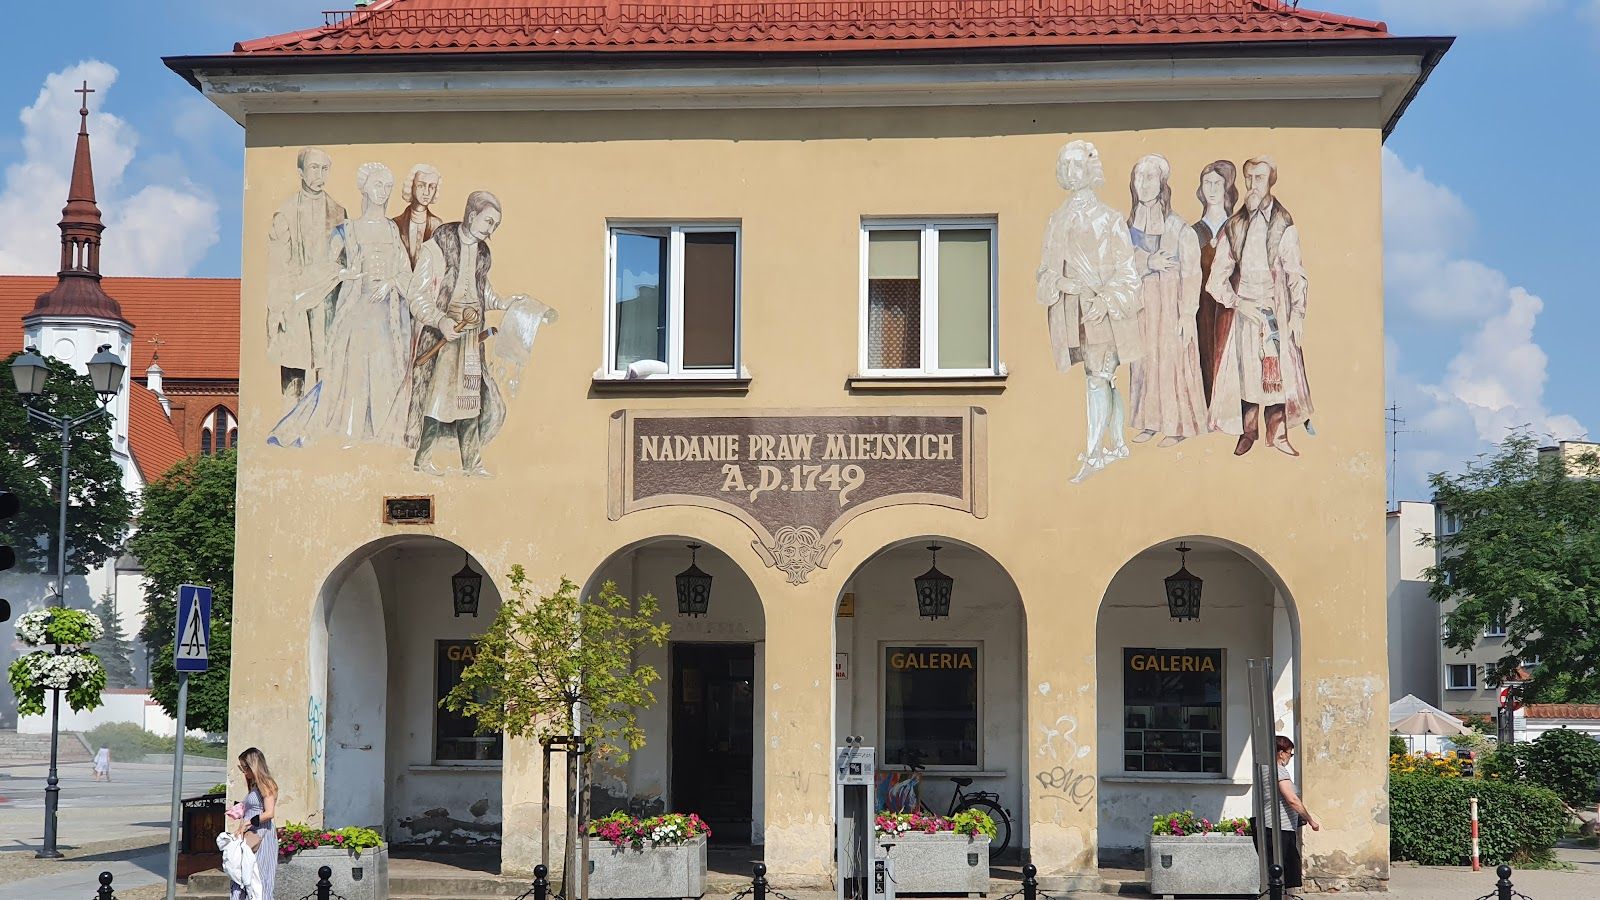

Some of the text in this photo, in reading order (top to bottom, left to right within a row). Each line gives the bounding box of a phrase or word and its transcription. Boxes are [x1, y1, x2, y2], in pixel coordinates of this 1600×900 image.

[640, 433, 954, 462] NADANIE PRAW MIEJSKICH
[890, 652, 973, 669] GALERIA
[1130, 654, 1215, 672] GALERIA
